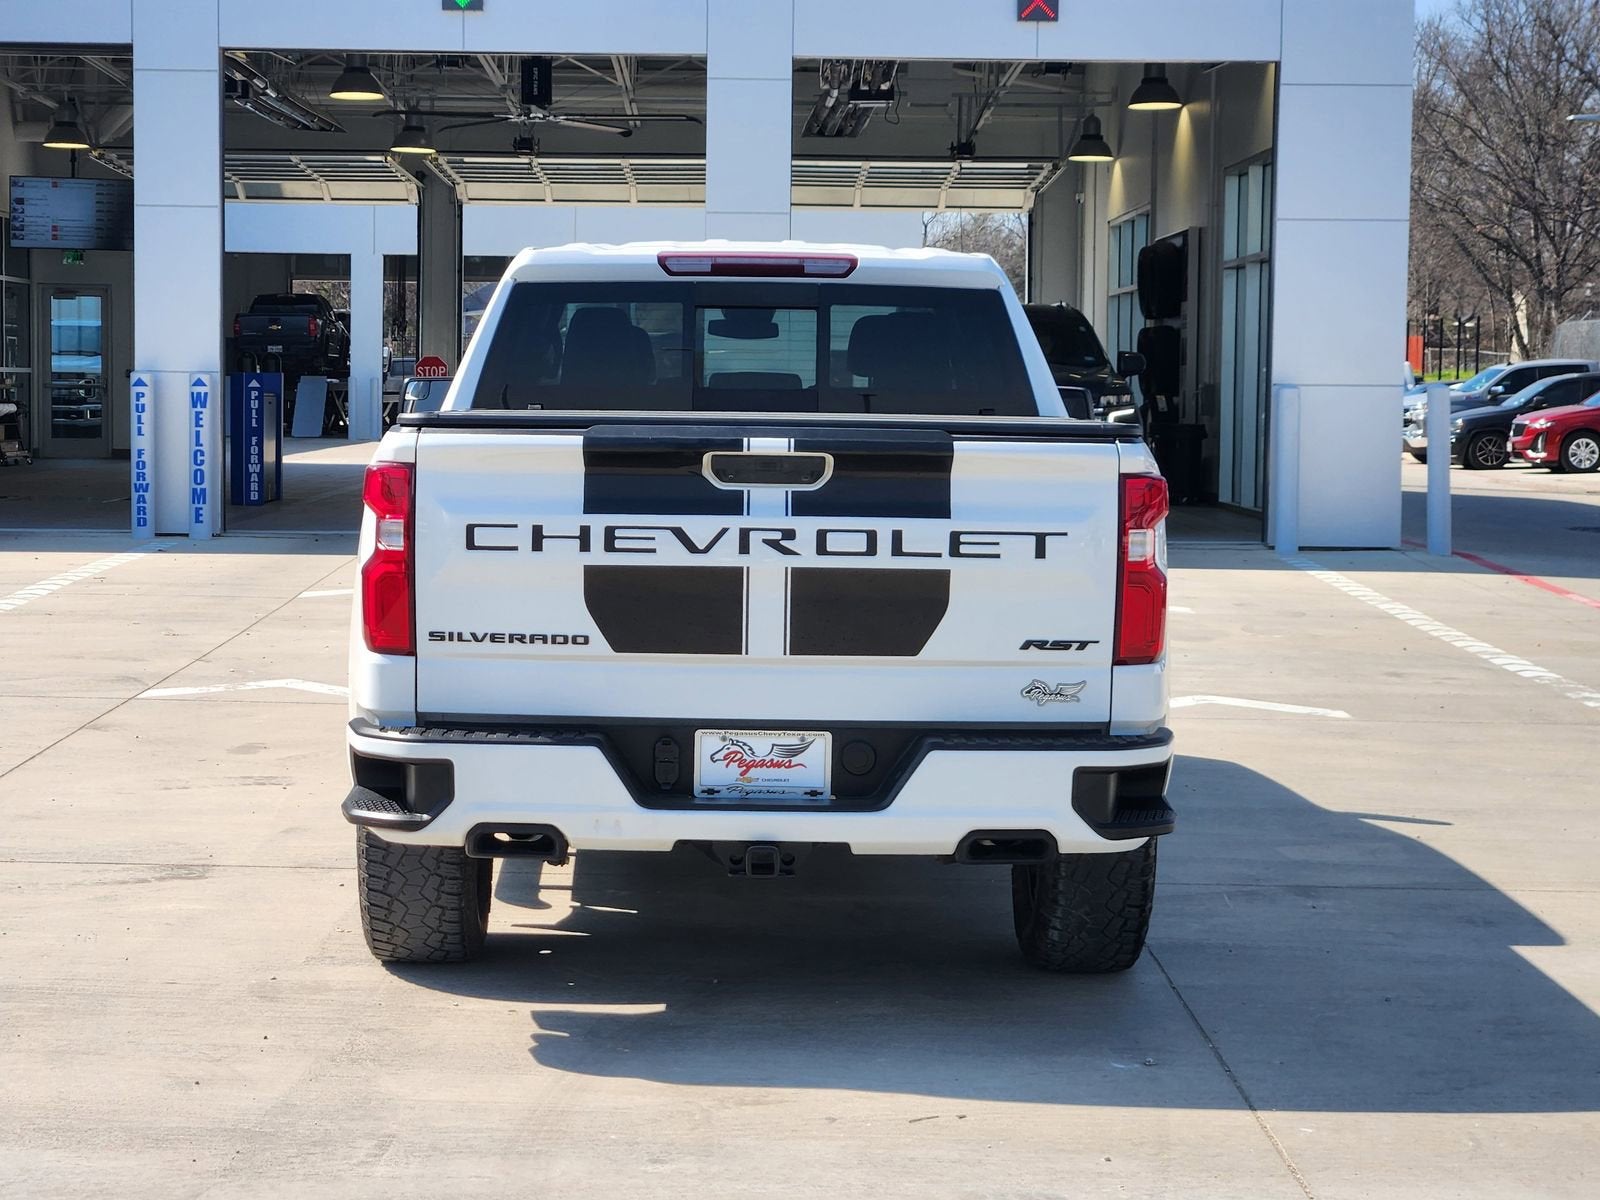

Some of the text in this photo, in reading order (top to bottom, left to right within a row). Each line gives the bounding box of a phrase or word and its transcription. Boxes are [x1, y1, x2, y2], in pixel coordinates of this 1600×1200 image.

[416, 366, 446, 377] STOP
[248, 390, 261, 501] PULL FORWARD
[133, 392, 150, 528] PULL FORWARD
[191, 391, 209, 524] WELCOME
[465, 523, 1068, 559] CHEVROLET
[428, 631, 590, 645] SILVERADO
[1019, 639, 1100, 651] RST
[1030, 688, 1081, 706] Pegasus
[722, 750, 807, 777] Pegasus
[726, 785, 798, 799] Pegasus
